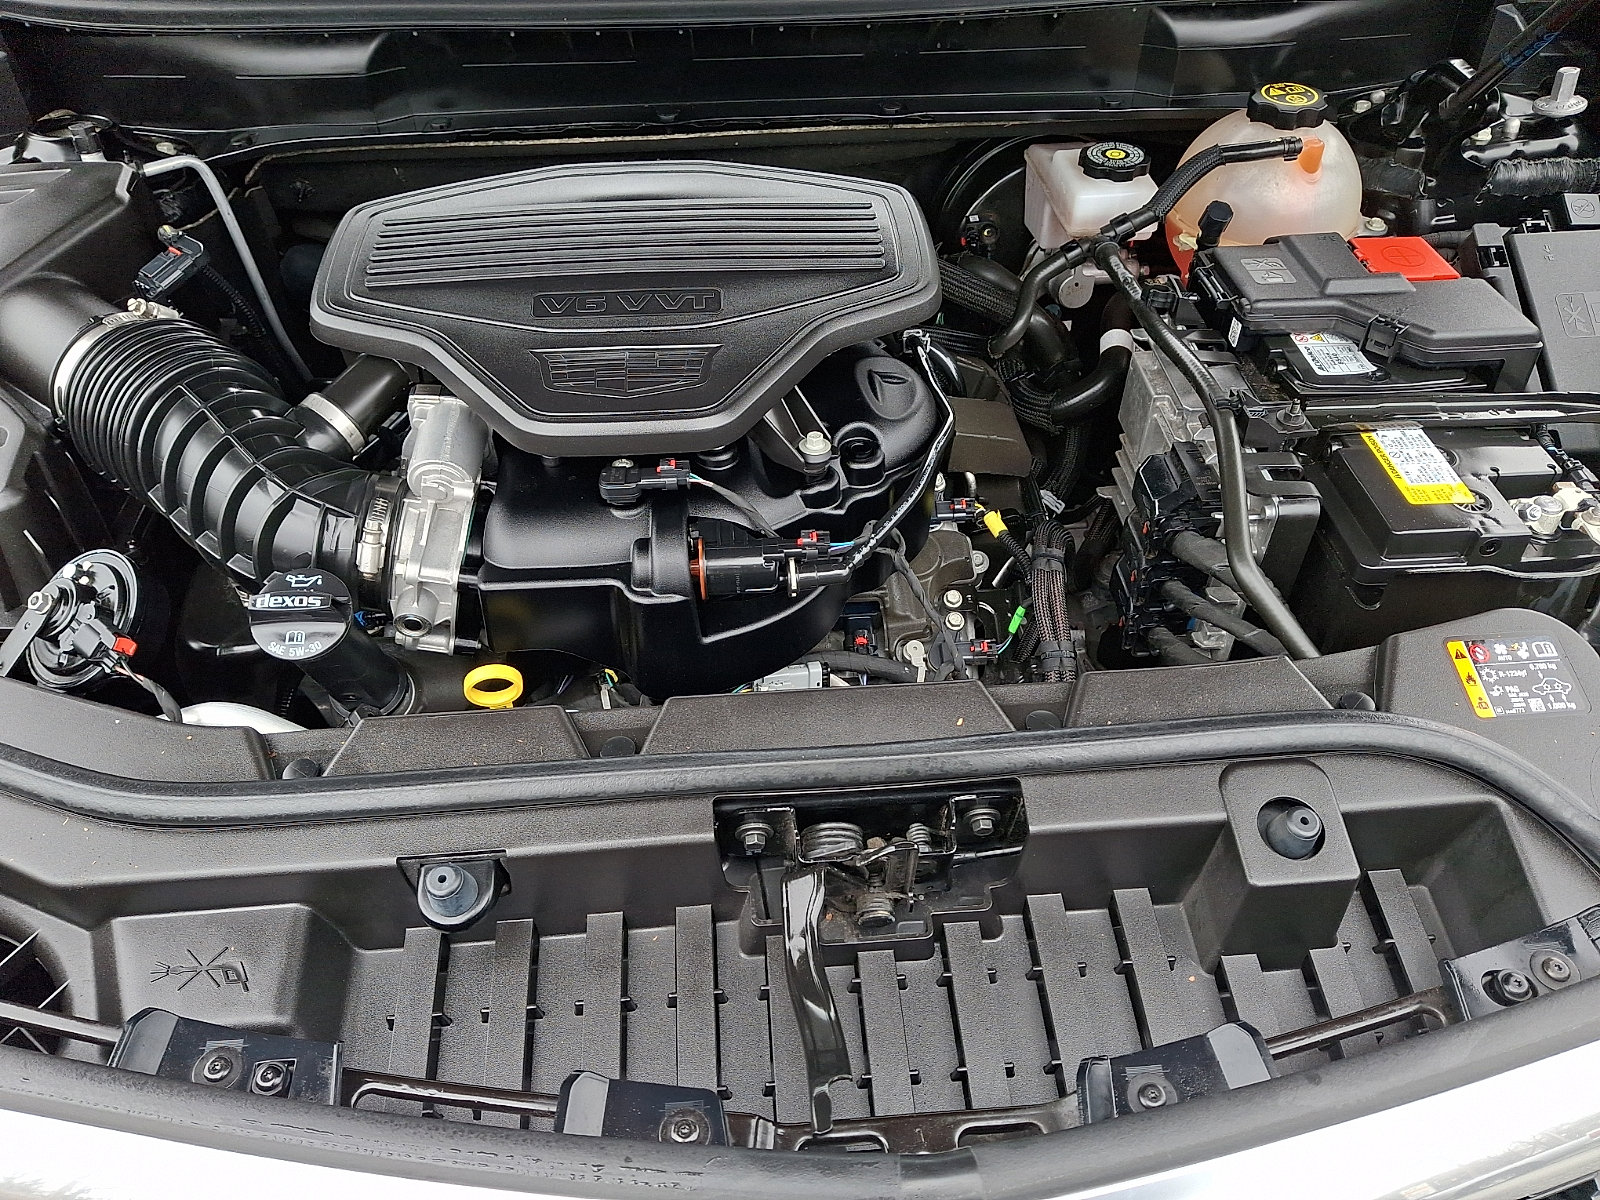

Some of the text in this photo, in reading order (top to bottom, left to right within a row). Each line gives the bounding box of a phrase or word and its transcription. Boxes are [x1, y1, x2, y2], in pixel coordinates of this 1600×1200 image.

[540, 292, 715, 313] V6 VVT
[255, 593, 323, 608] dexos
[267, 640, 323, 657] SAE 5W-30
